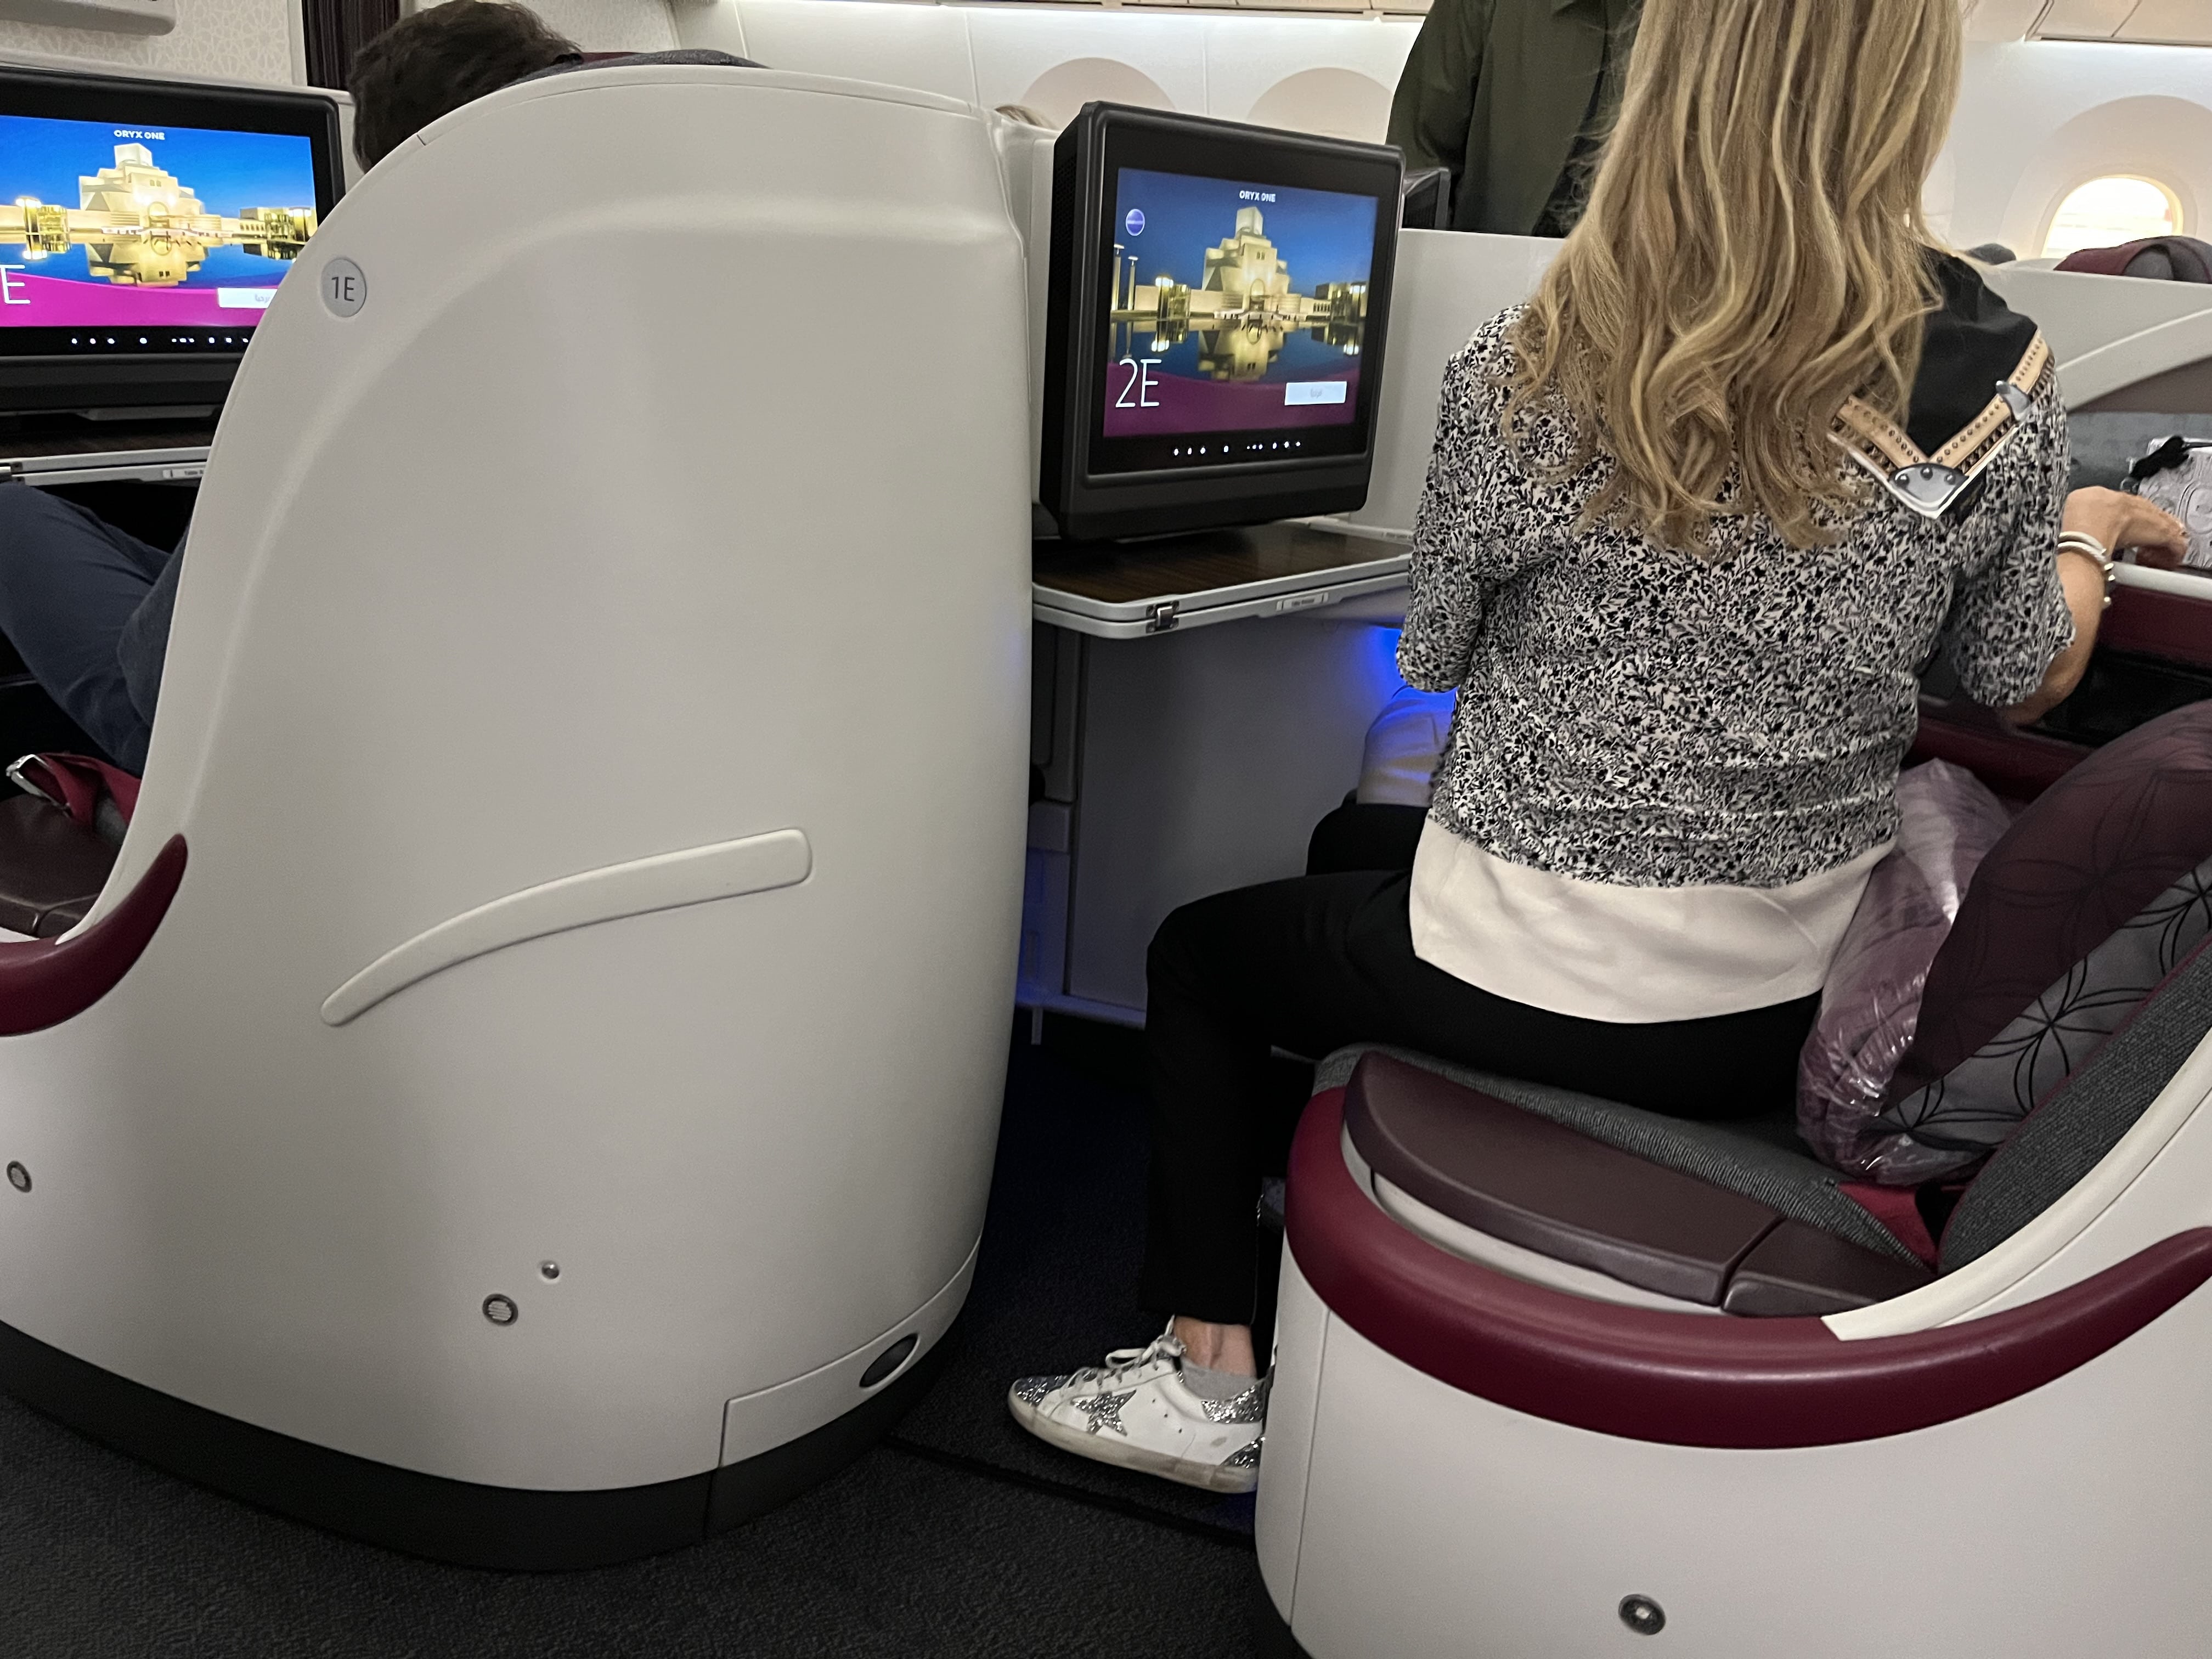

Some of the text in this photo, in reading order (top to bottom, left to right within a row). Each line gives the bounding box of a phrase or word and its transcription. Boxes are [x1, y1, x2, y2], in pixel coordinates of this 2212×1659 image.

[114, 129, 165, 140] ORYX ONE
[1239, 190, 1276, 203] ORYX ONE
[331, 276, 355, 302] 1E
[1115, 358, 1162, 408] 2E
